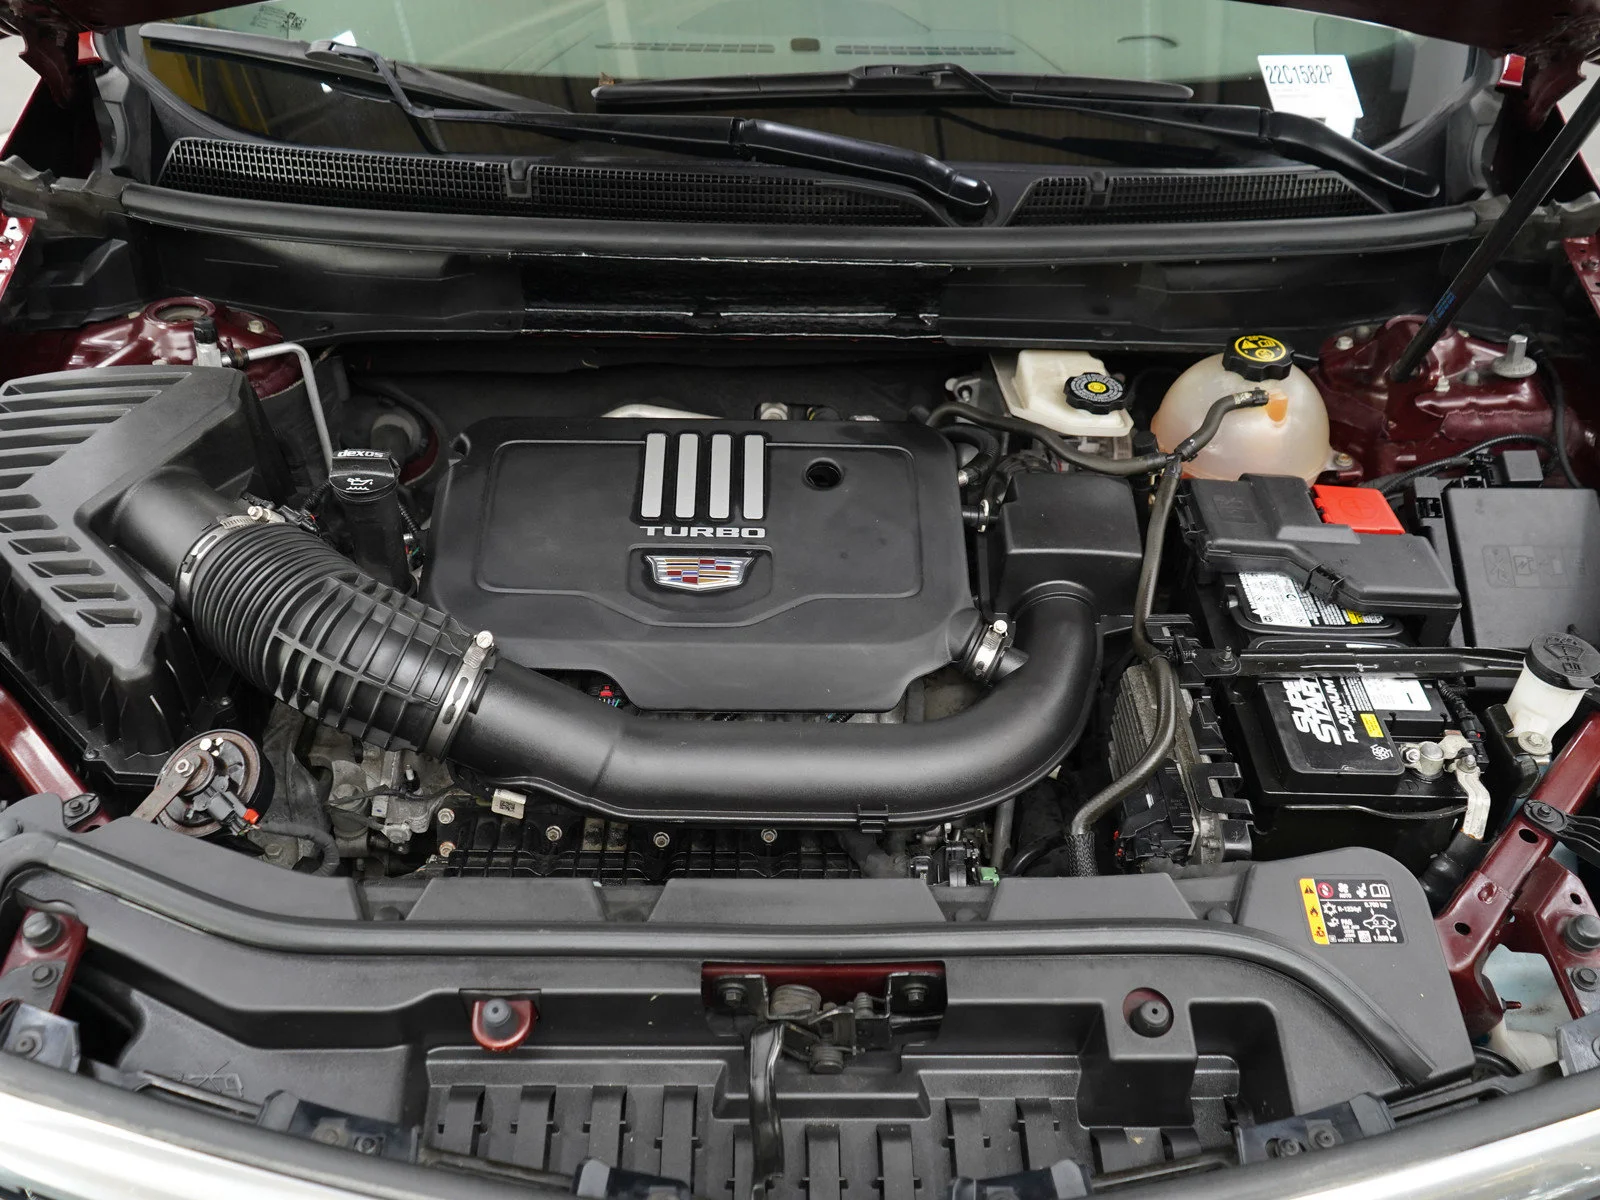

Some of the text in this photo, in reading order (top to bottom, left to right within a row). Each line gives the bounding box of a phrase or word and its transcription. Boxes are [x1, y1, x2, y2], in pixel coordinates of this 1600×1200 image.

[1265, 65, 1333, 84] 22C1582P
[337, 449, 385, 458] dexos
[639, 526, 766, 539] TURBO
[1283, 681, 1311, 733] SUPE
[1322, 679, 1360, 743] PLATINUM
